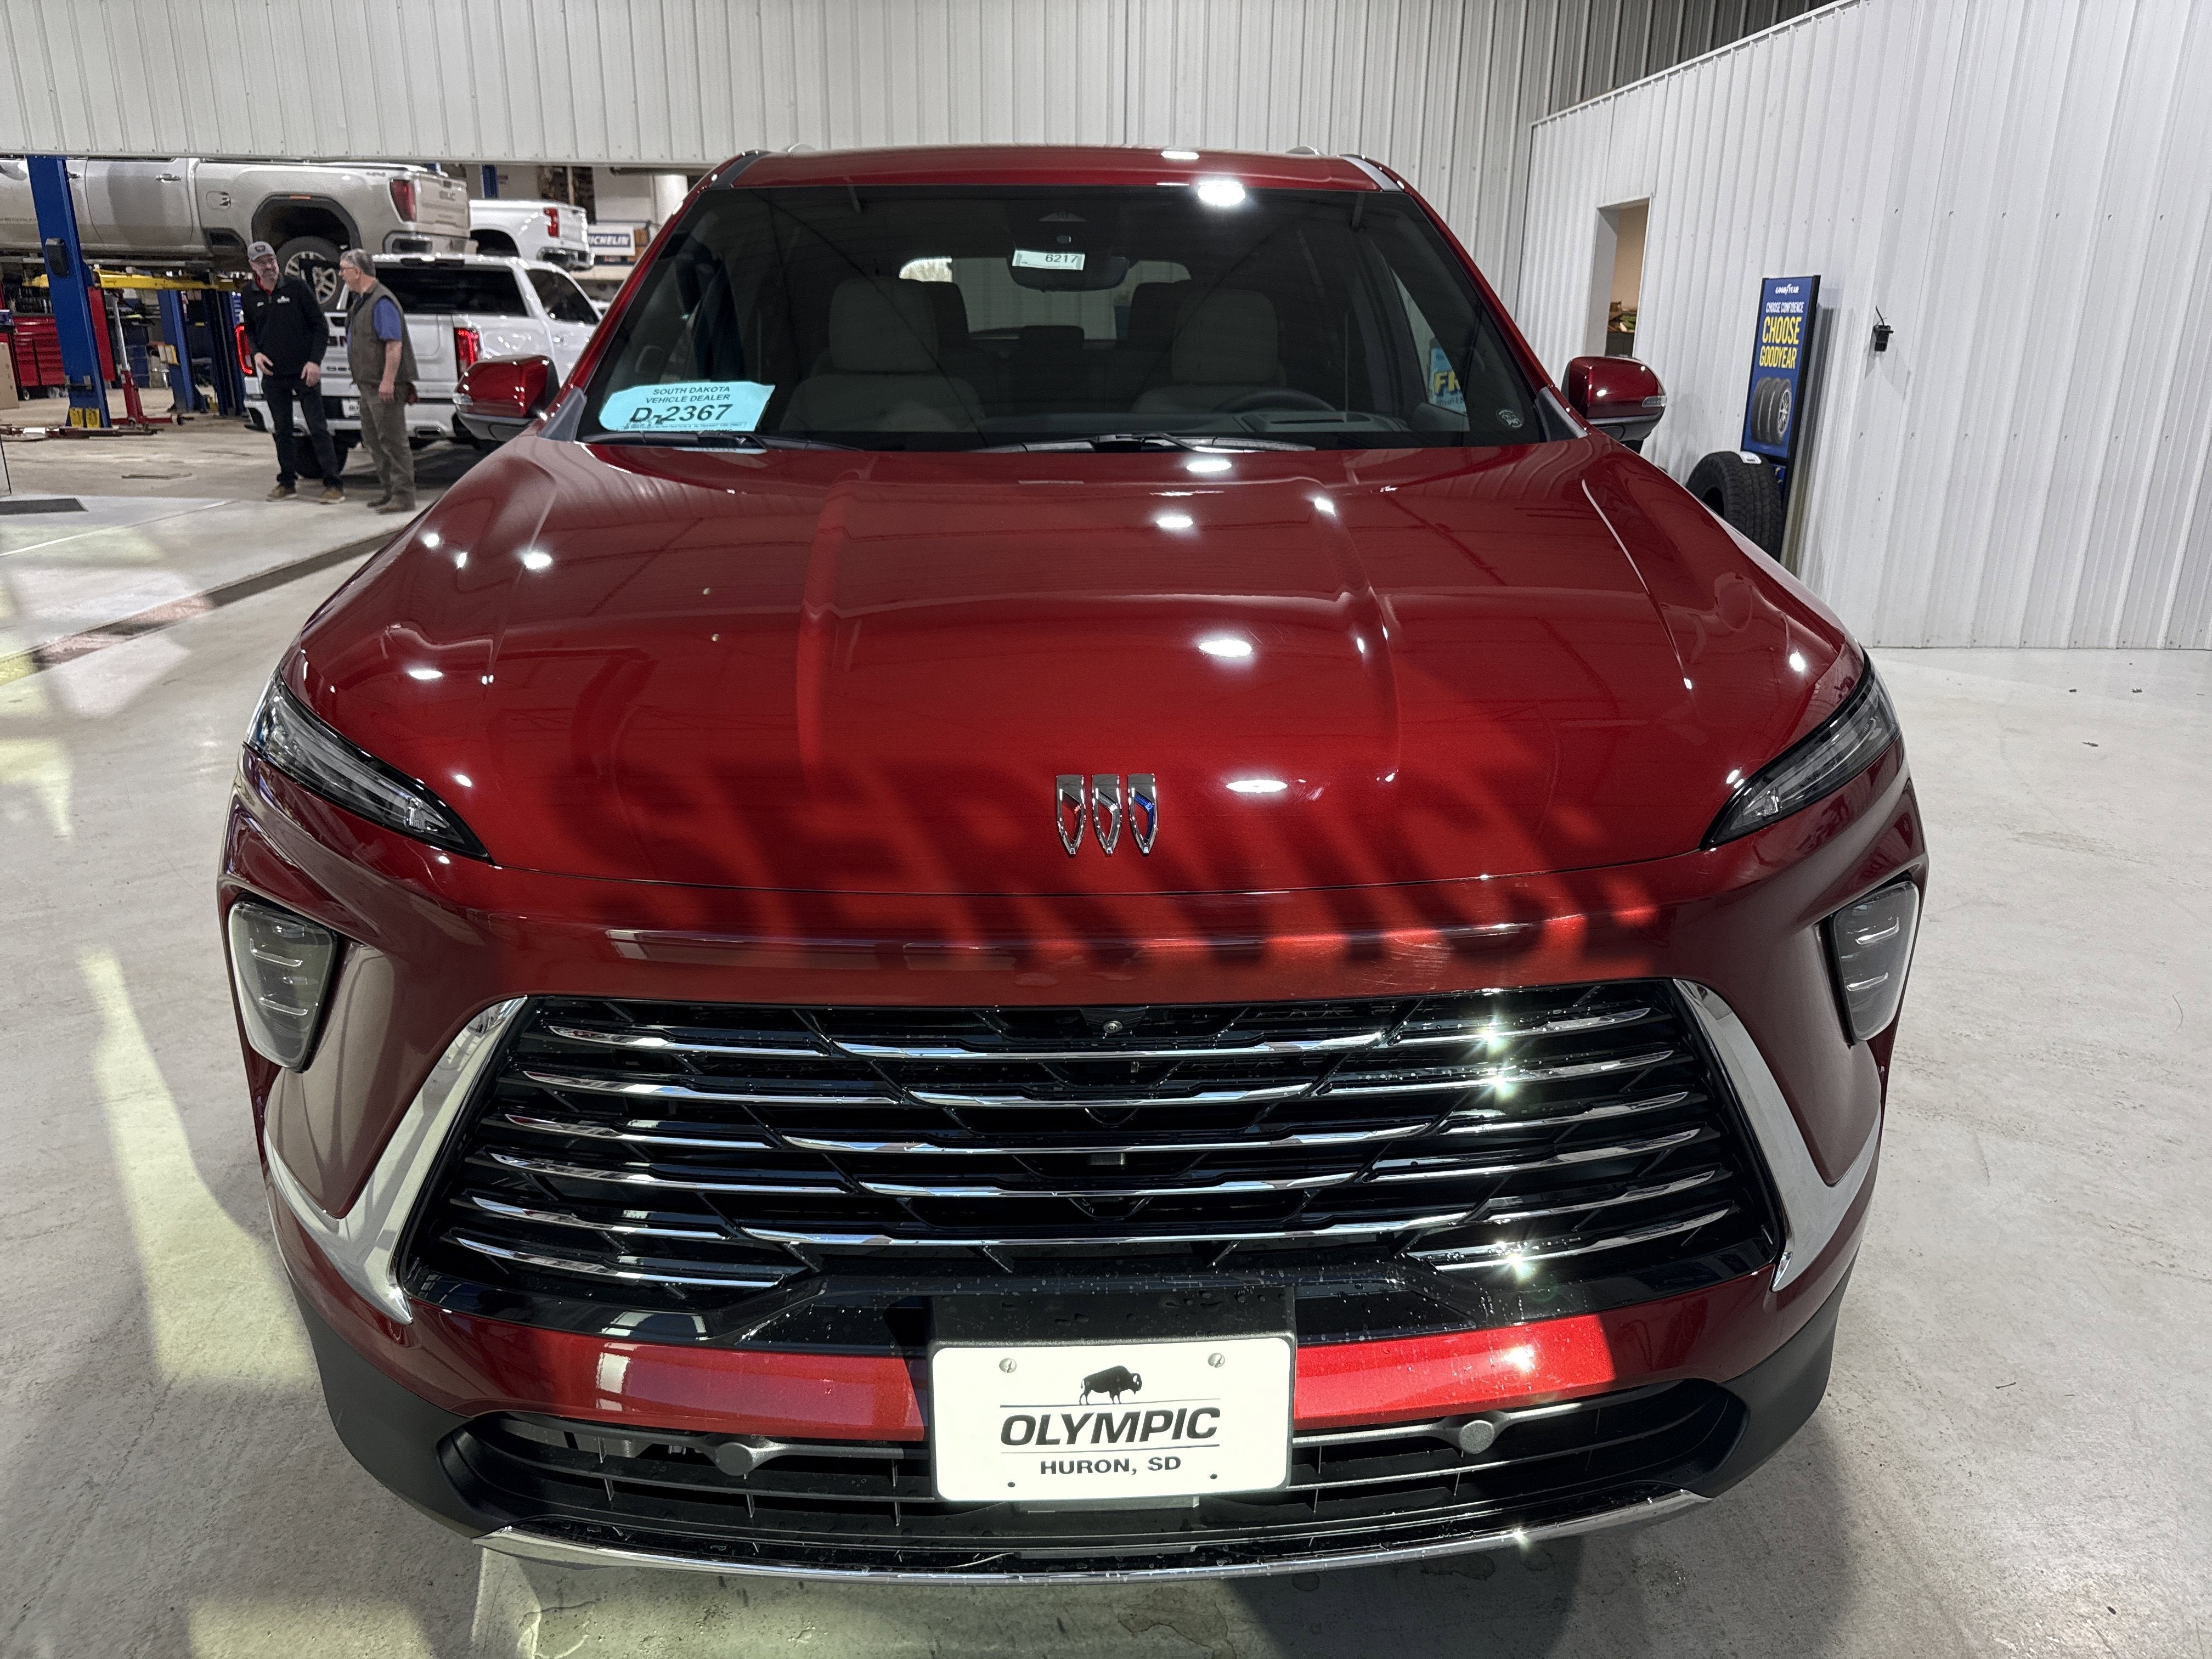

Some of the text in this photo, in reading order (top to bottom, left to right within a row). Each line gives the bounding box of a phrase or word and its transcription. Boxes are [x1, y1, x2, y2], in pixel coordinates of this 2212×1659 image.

[1045, 254, 1079, 263] 6217
[1775, 284, 1799, 296] GOODYEAR
[1765, 301, 1804, 313] CHOOSE CONFIDENCE
[1762, 315, 1802, 345] CHOOSE
[1759, 345, 1798, 369] GOODYEAR
[646, 394, 731, 404] VEHICLE DEALER
[629, 404, 733, 424] D-2367
[1001, 1407, 1221, 1446] OLYMPIC
[1040, 1455, 1181, 1476] HURON, SD
